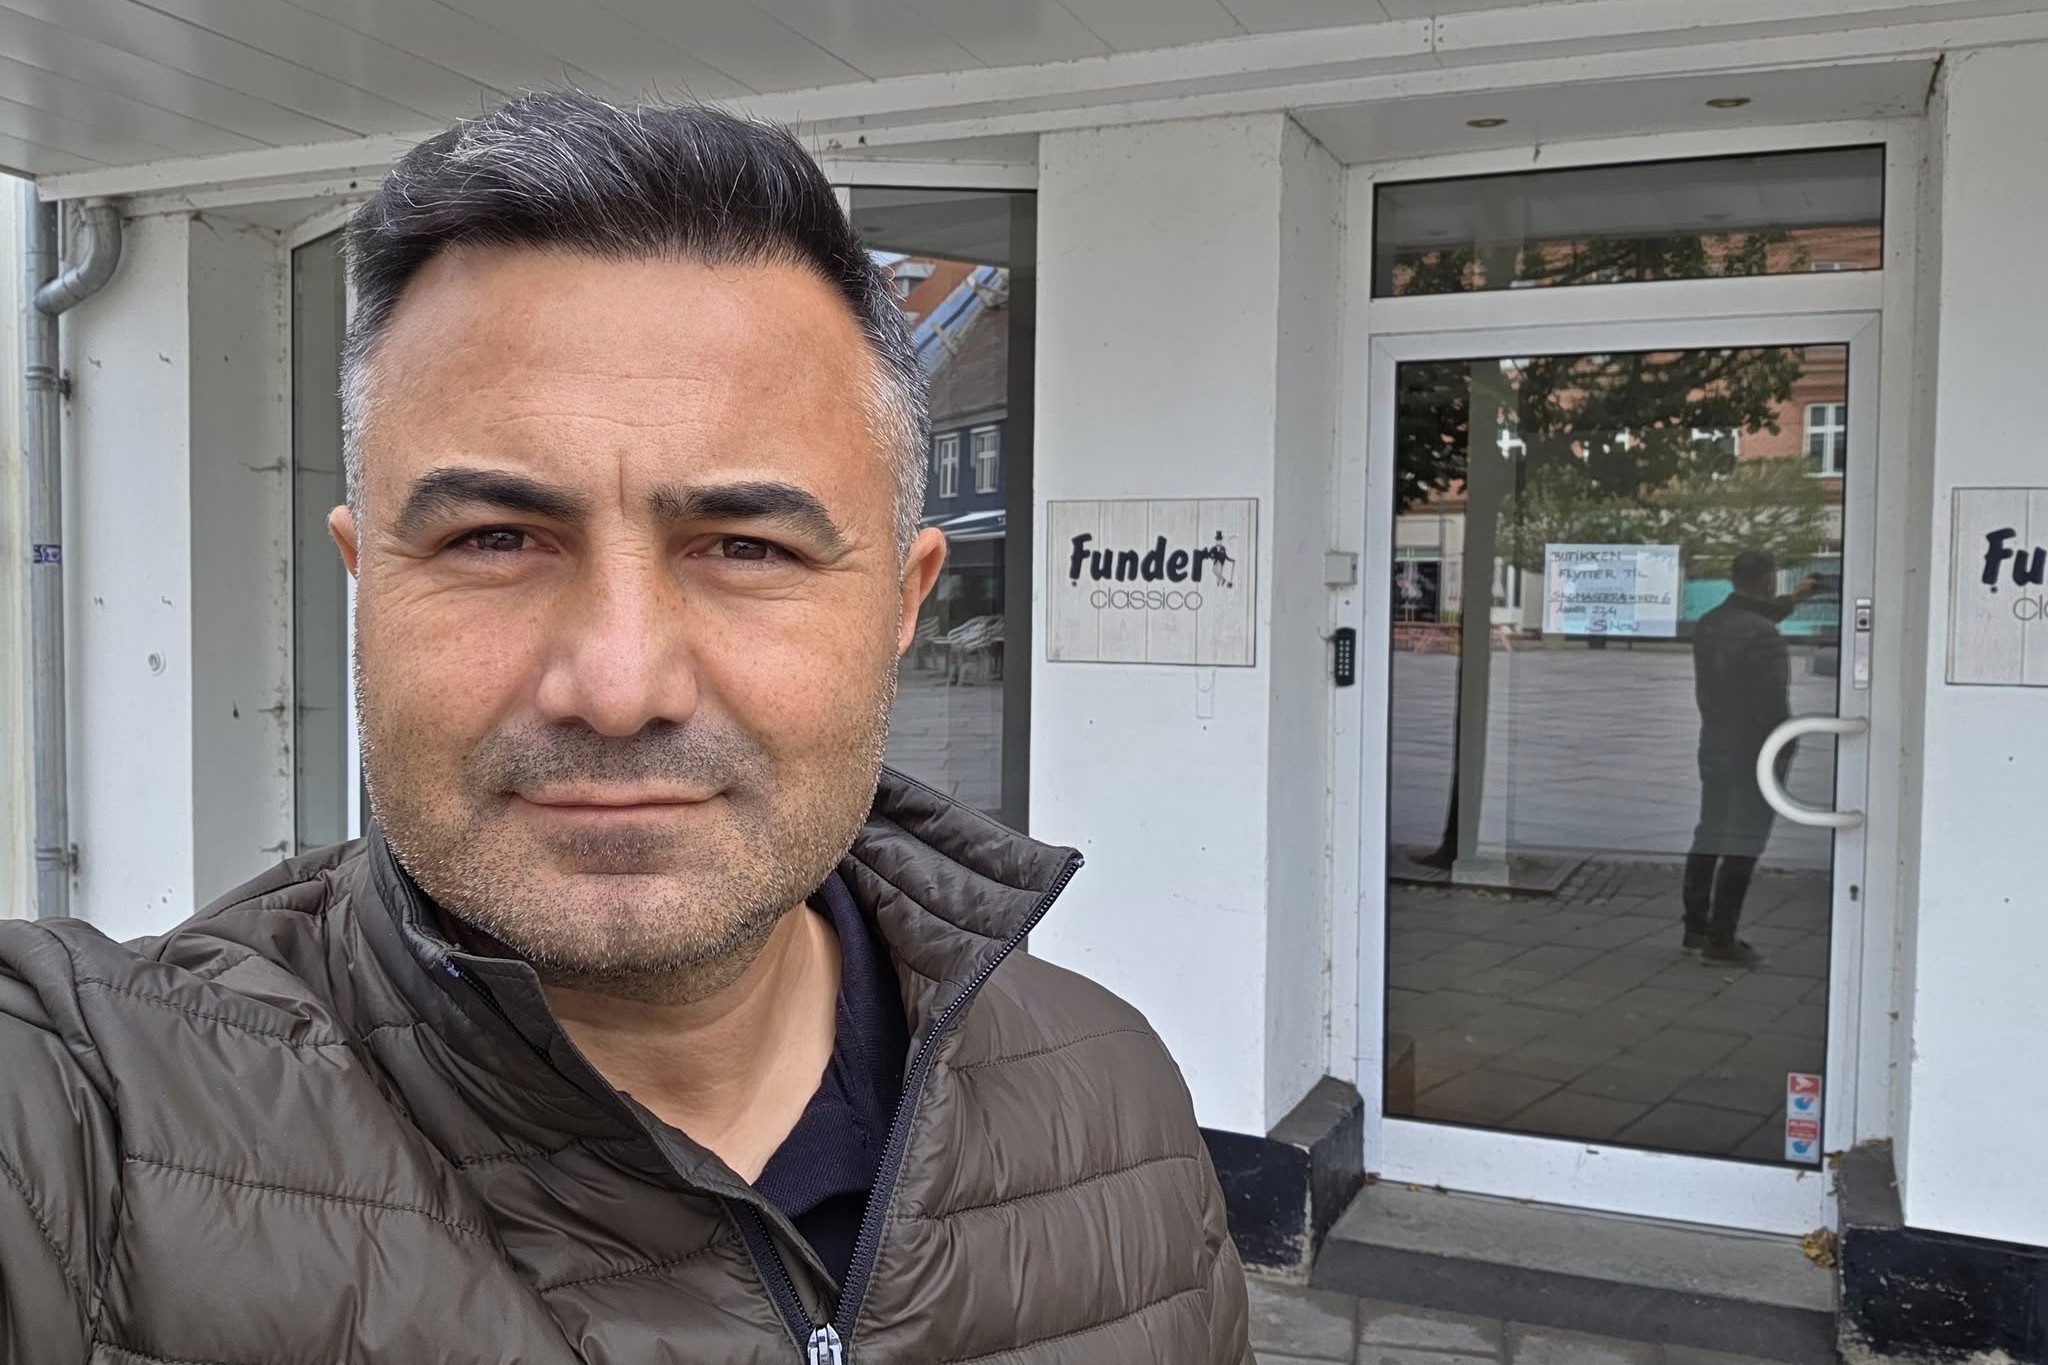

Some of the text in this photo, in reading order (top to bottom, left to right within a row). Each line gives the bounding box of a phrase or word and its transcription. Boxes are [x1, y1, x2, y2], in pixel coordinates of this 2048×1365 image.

[1069, 533, 1209, 584] Funder
[1981, 527, 2048, 587] Fu
[1559, 569, 1617, 582] FLYTTER
[1090, 587, 1204, 611] classico
[2012, 594, 2048, 621] cl
